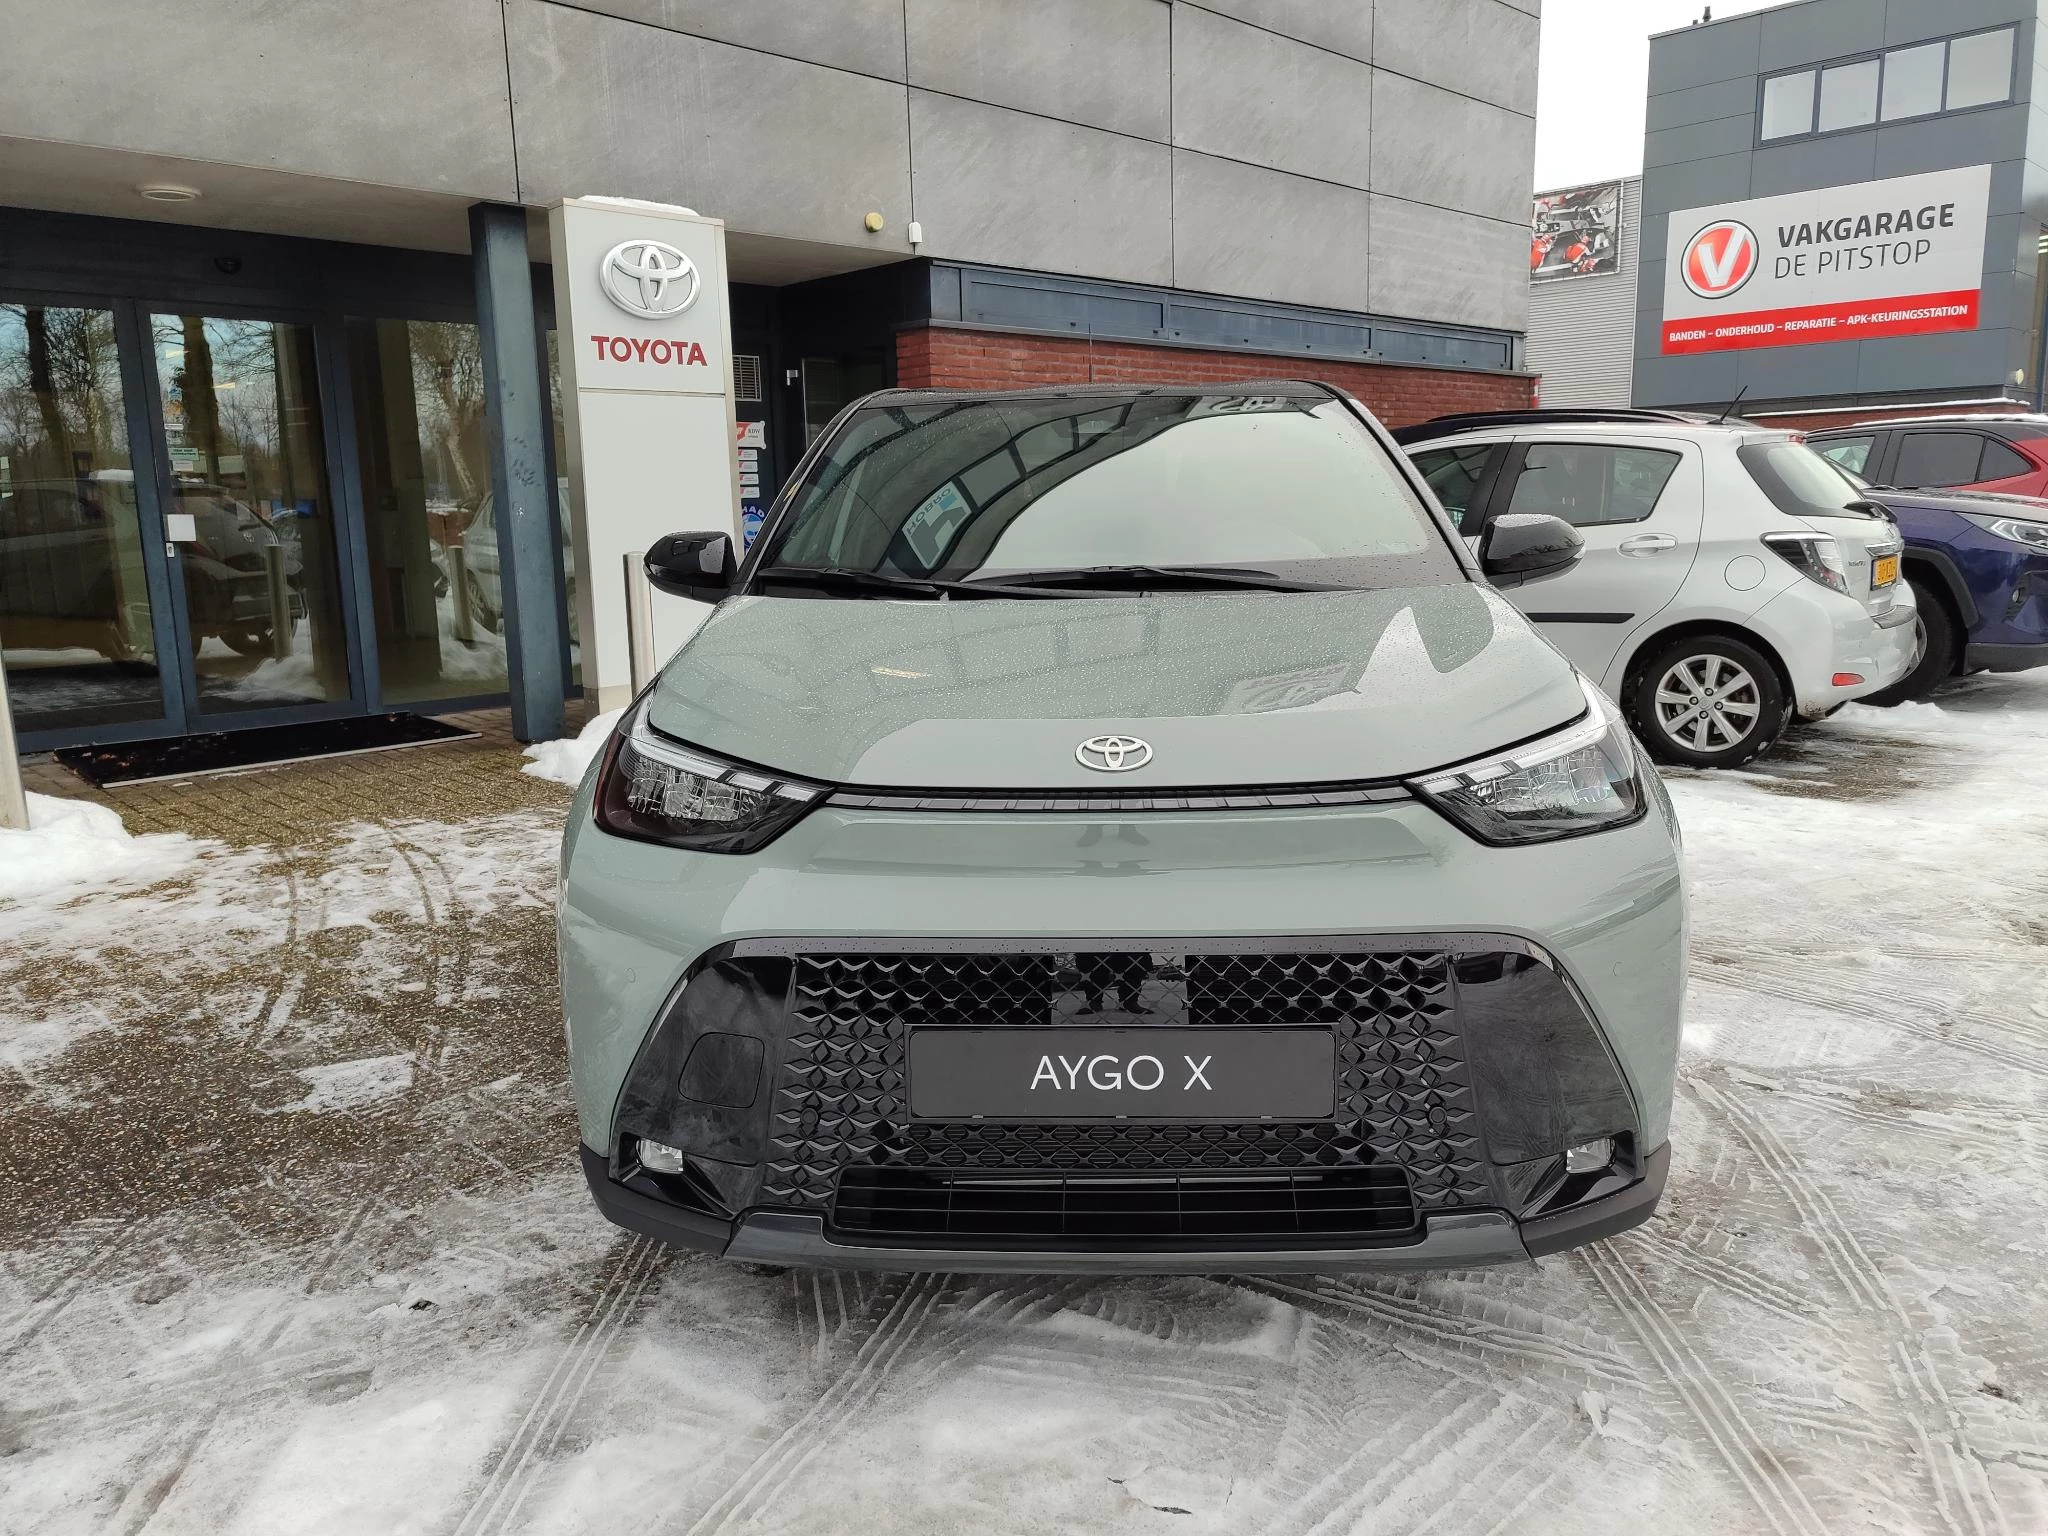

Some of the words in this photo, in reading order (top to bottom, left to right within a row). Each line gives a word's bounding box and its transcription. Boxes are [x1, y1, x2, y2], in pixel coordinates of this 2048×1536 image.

[1778, 203, 1954, 248] VAKGARAGE
[1775, 254, 1806, 279] DE
[1818, 239, 1931, 274] PITSTOP
[1669, 330, 1706, 342] BANDEN
[1715, 323, 1775, 338] ONDERHOUD
[1784, 317, 1837, 331] REPARATIE
[1847, 305, 1968, 325] APK-KEURINGSSTATION
[590, 335, 708, 366] TOYOTA
[1030, 1055, 1164, 1090] AYGO
[1183, 1055, 1212, 1090] X
